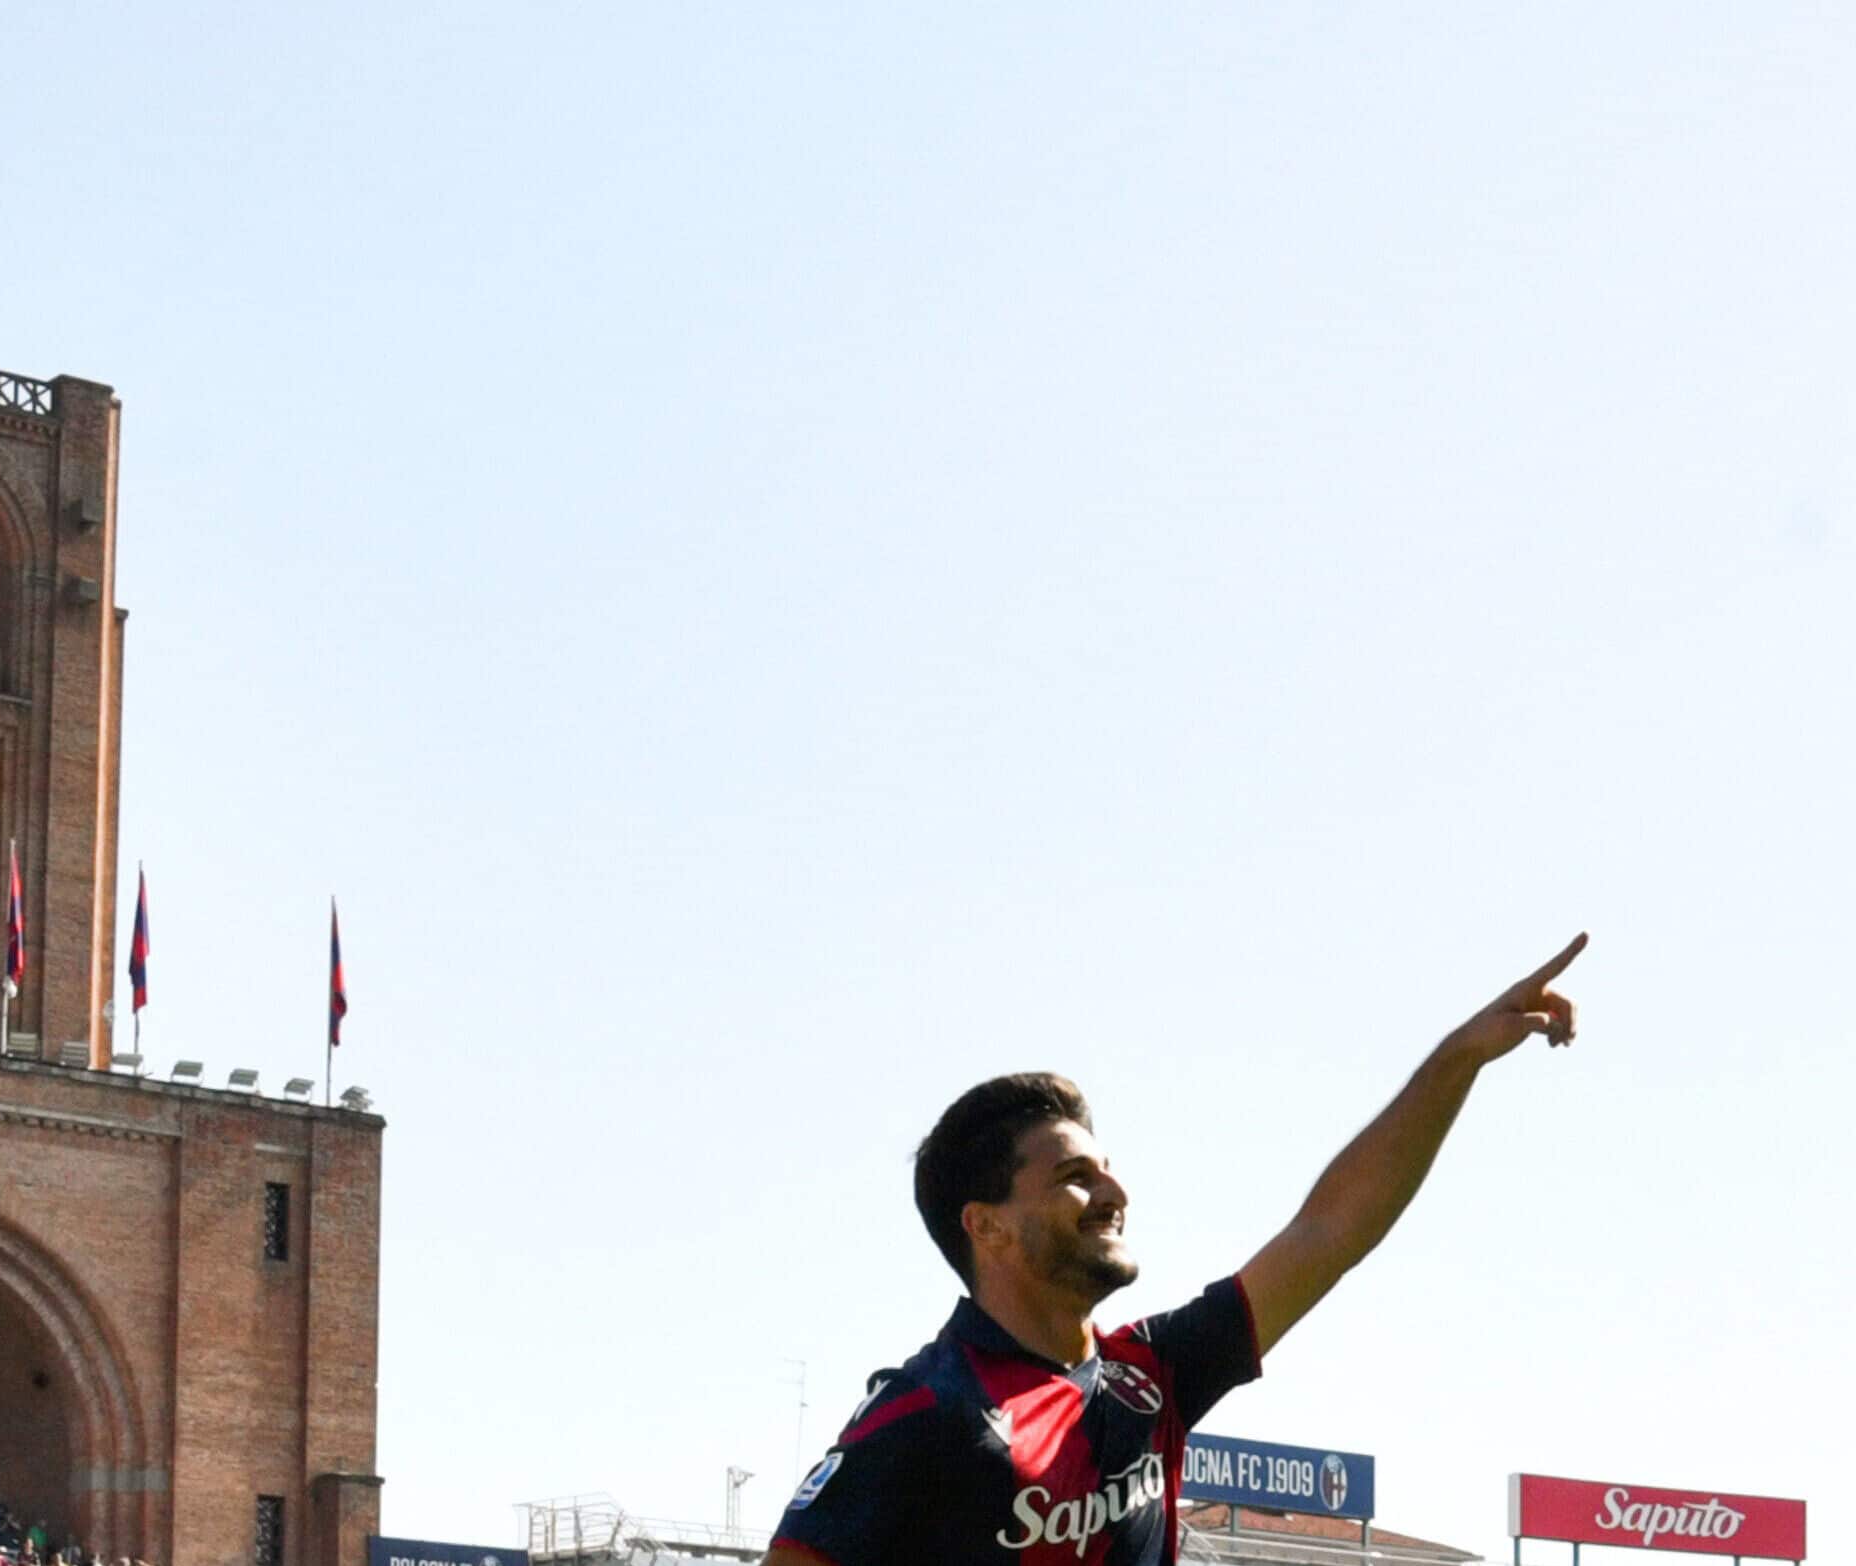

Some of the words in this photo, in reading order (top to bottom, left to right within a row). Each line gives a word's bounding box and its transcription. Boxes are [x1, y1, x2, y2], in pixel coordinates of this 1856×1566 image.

[1238, 1451, 1263, 1491] FC
[1266, 1455, 1314, 1497] 1909
[1595, 1487, 1746, 1546] Saputo
